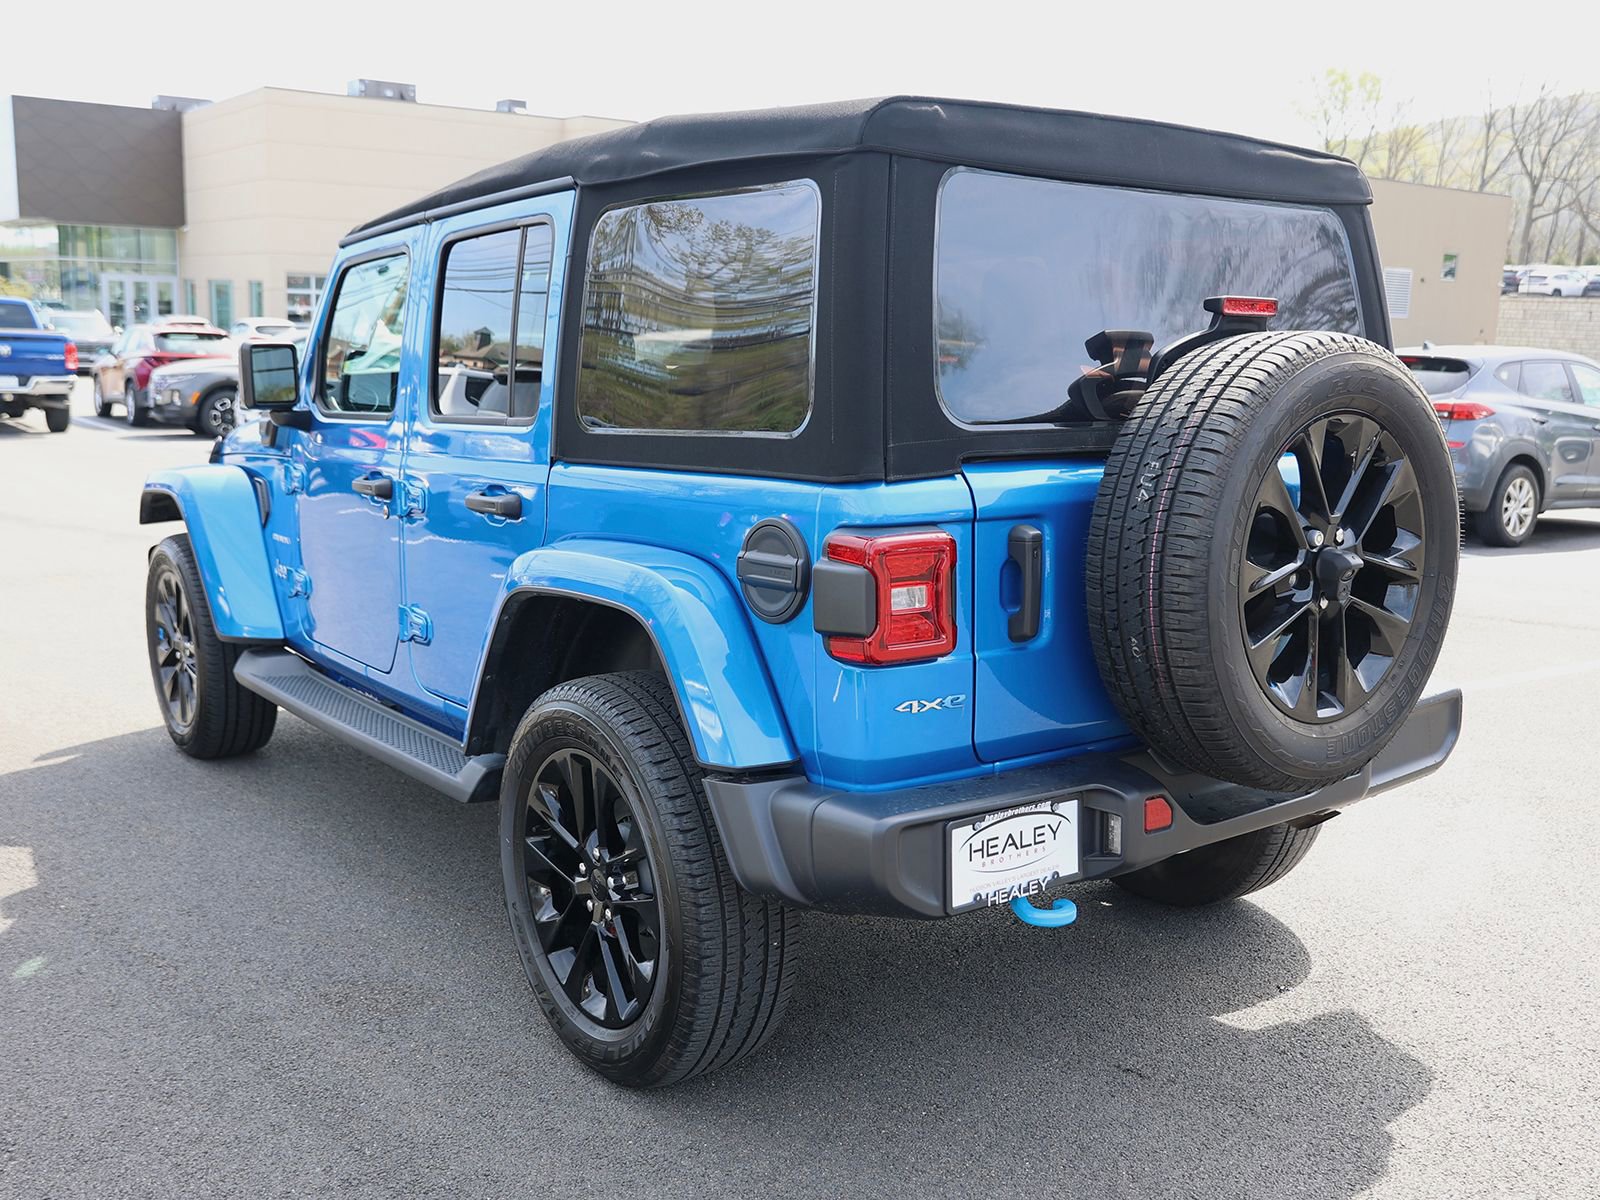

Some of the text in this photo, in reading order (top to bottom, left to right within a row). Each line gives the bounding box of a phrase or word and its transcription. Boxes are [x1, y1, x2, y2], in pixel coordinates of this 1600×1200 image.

[1326, 574, 1455, 759] BRIDGESTONE
[969, 820, 1062, 862] HEALEY
[981, 846, 1046, 868] BROTHERS
[987, 876, 1049, 907] HEALEY
